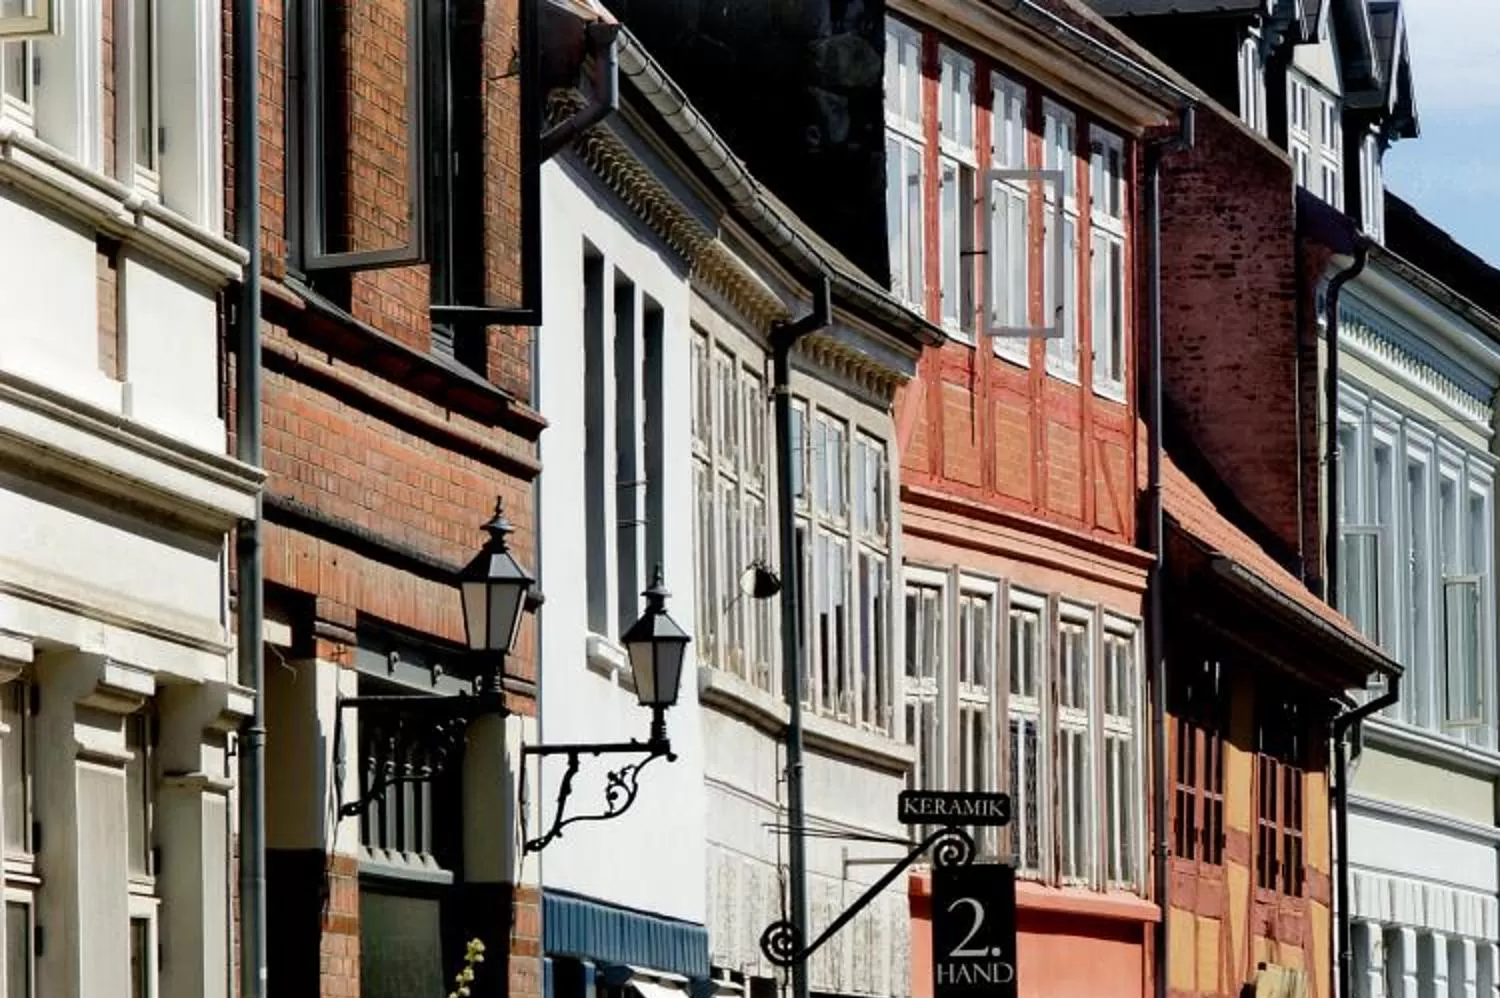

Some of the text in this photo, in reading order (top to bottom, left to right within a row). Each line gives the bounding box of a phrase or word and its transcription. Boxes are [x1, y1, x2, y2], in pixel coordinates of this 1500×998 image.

[904, 797, 1005, 817] KERAMIK
[947, 897, 1001, 957] 2.
[937, 962, 1014, 985] HAND
